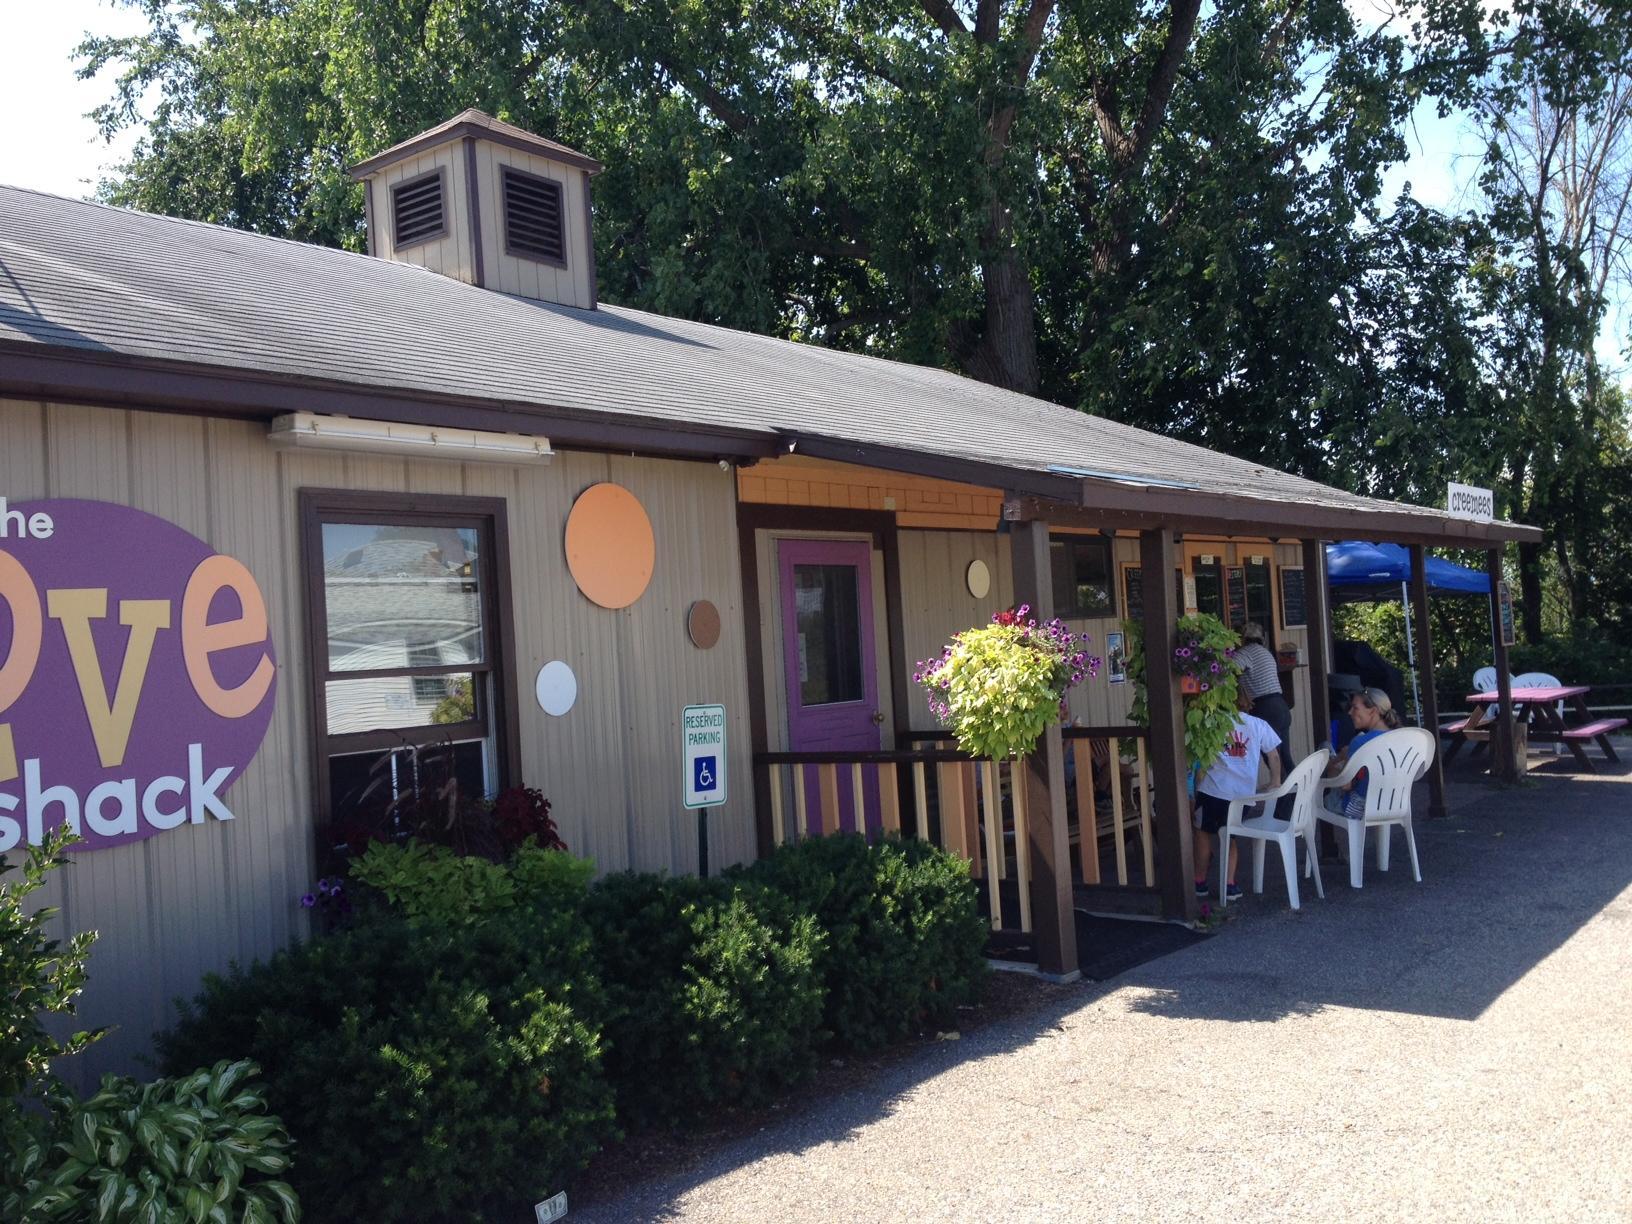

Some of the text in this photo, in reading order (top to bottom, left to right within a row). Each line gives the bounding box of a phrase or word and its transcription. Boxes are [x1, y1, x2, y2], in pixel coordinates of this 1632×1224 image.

[1451, 491, 1491, 517] creemees
[0, 497, 54, 539] he
[685, 714, 722, 729] RESERVED
[688, 731, 721, 746] PARKING
